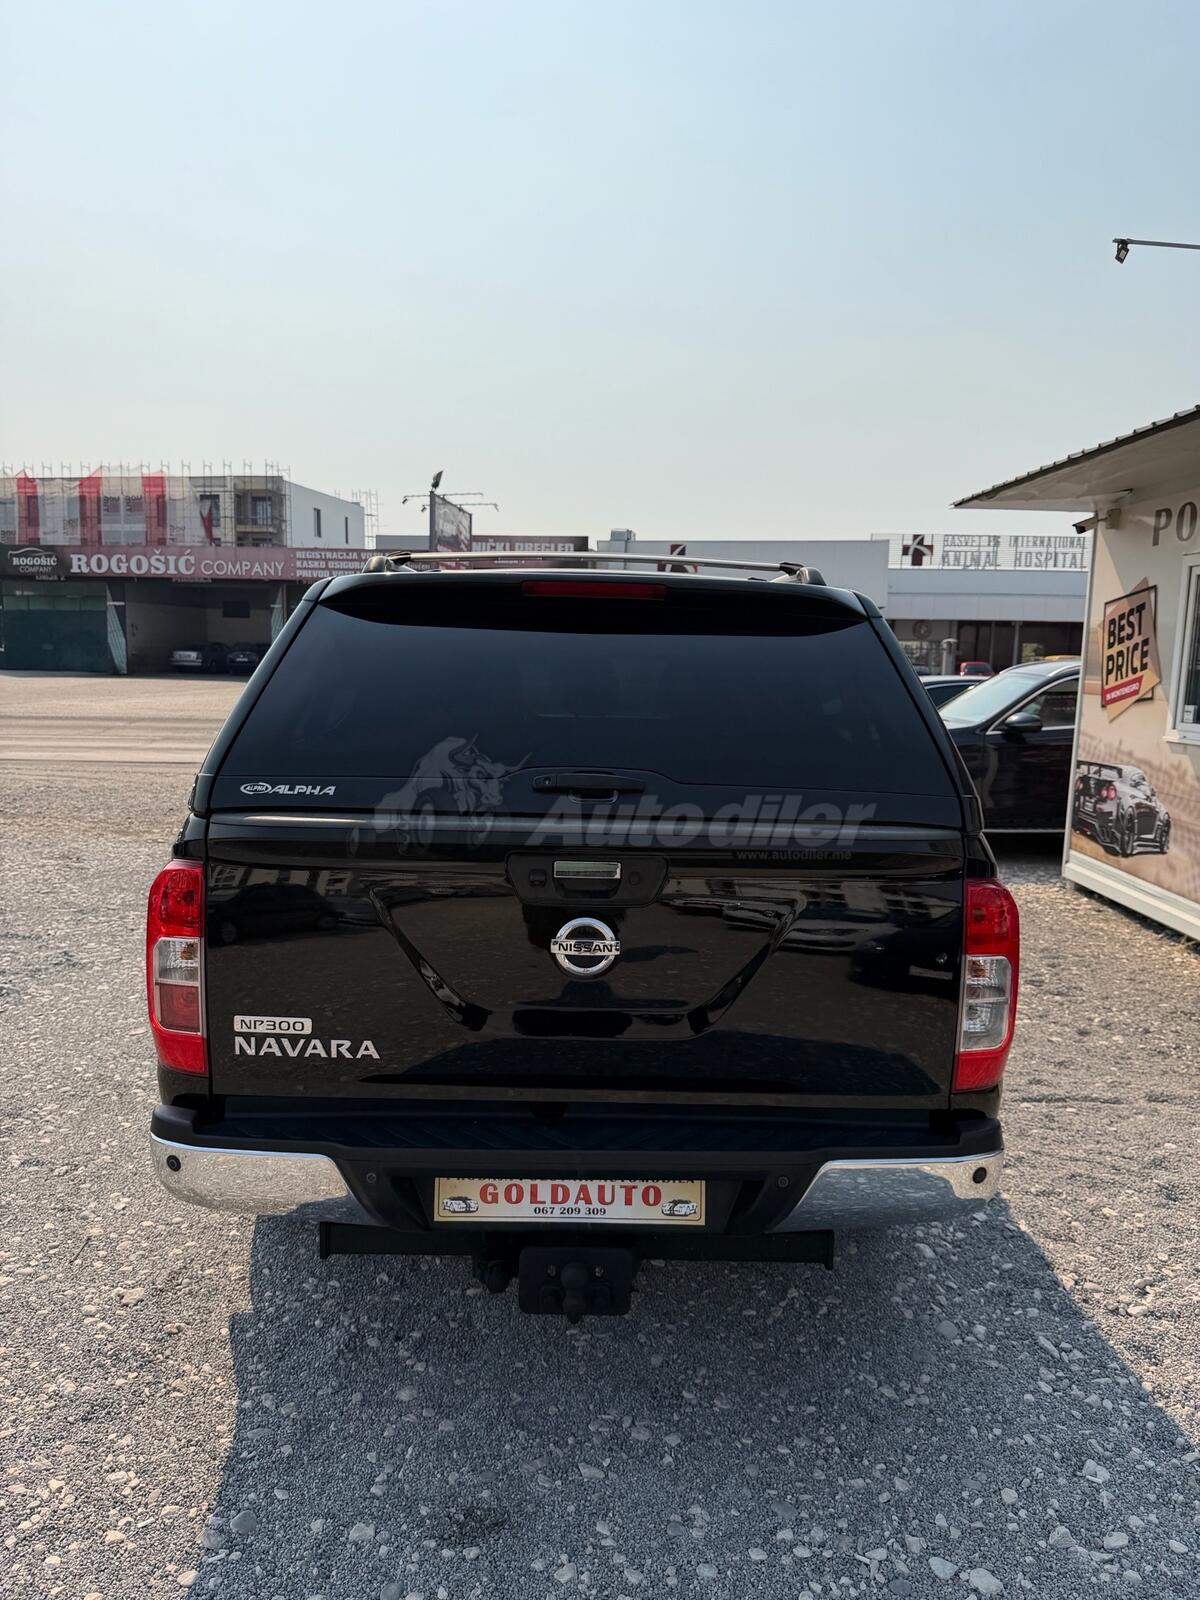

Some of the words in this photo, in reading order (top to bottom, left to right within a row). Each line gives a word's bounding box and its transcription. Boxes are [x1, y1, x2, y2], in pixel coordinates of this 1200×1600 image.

[70, 548, 196, 575] ROGOŠIĆ
[201, 560, 285, 577] COMPANY
[942, 551, 1000, 567] ANIMAL
[1014, 552, 1088, 568] HOSPITAL
[1107, 602, 1147, 650] BEST
[1105, 638, 1149, 686] PRICE
[269, 784, 336, 796] ALPHA
[558, 942, 613, 953] NISSAN
[240, 1019, 305, 1032] NP300
[234, 1036, 381, 1059] NAVARA
[479, 1183, 662, 1207] GOLDAUTO
[533, 1206, 556, 1215] 067
[559, 1207, 581, 1216] 209
[584, 1207, 607, 1216] 309
